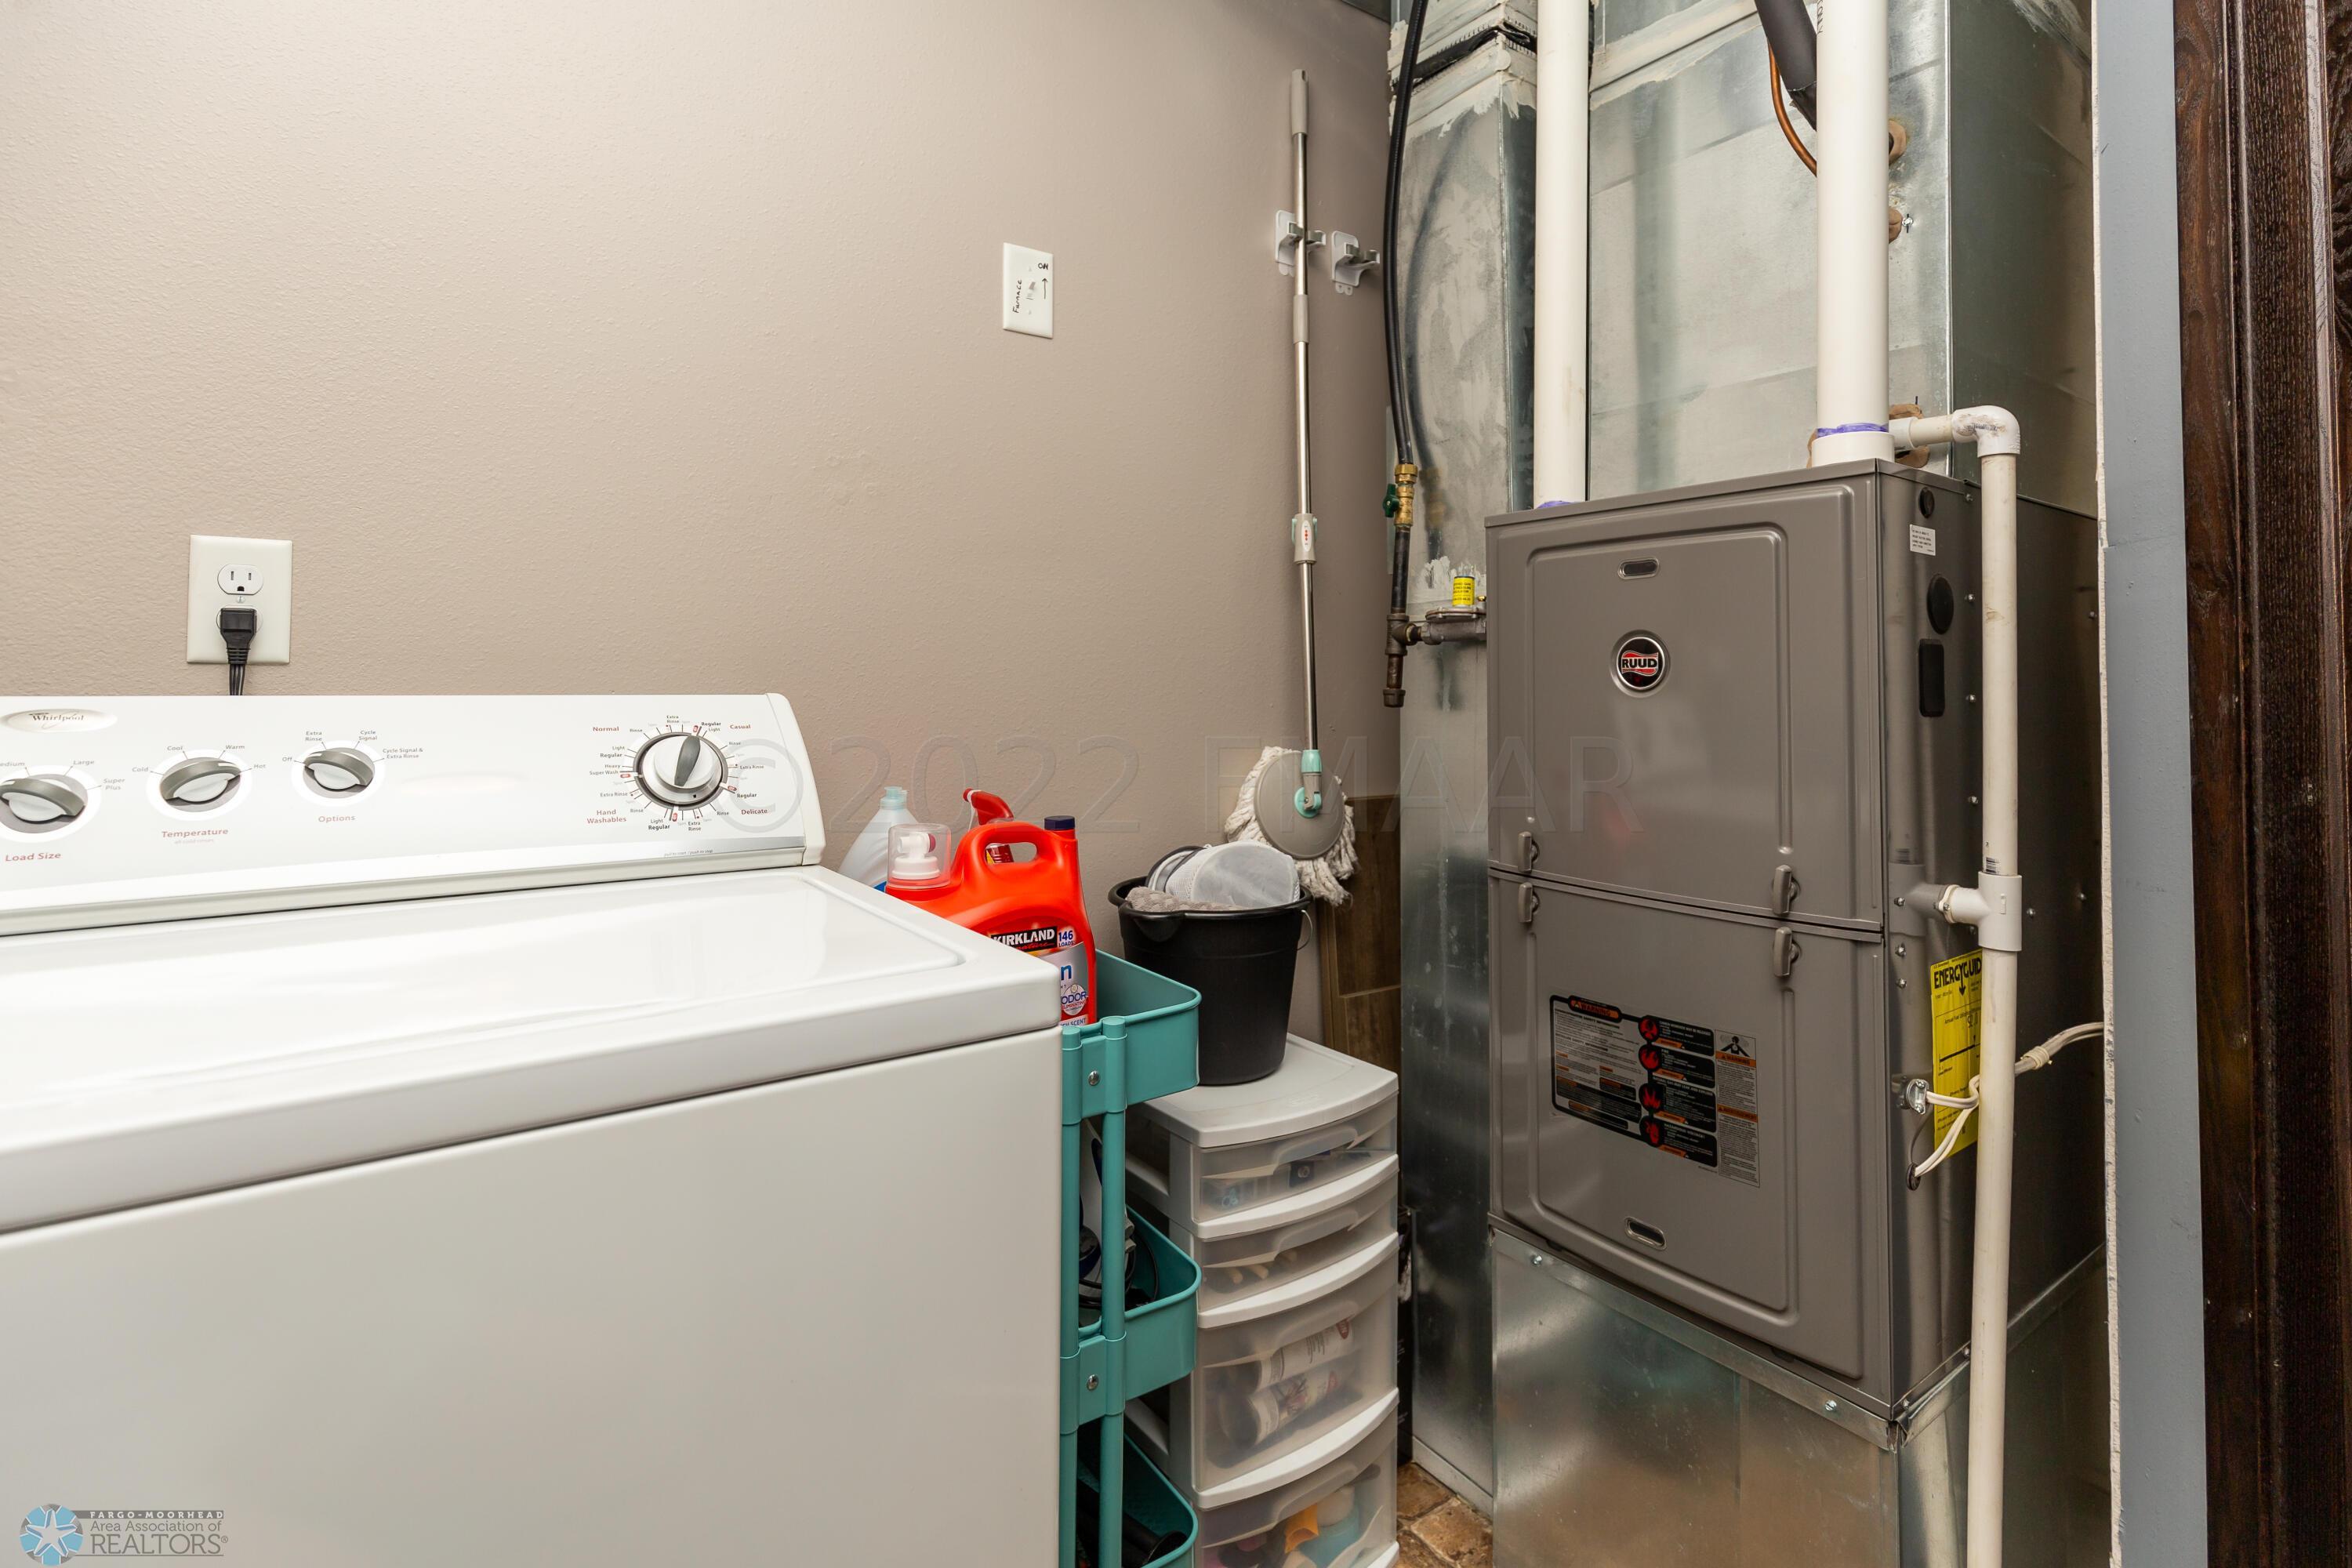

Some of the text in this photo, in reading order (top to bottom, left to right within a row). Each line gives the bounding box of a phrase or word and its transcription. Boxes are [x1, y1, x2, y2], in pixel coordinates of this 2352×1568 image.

[1621, 658, 1658, 669] RUUD
[162, 829, 229, 838] Temperature
[5, 853, 35, 862] Load
[1058, 931, 1073, 942] 146
[1934, 957, 1982, 989] ENERGYGUID
[1061, 991, 1087, 1004] ODOR
[1071, 1018, 1086, 1026] SCENT
